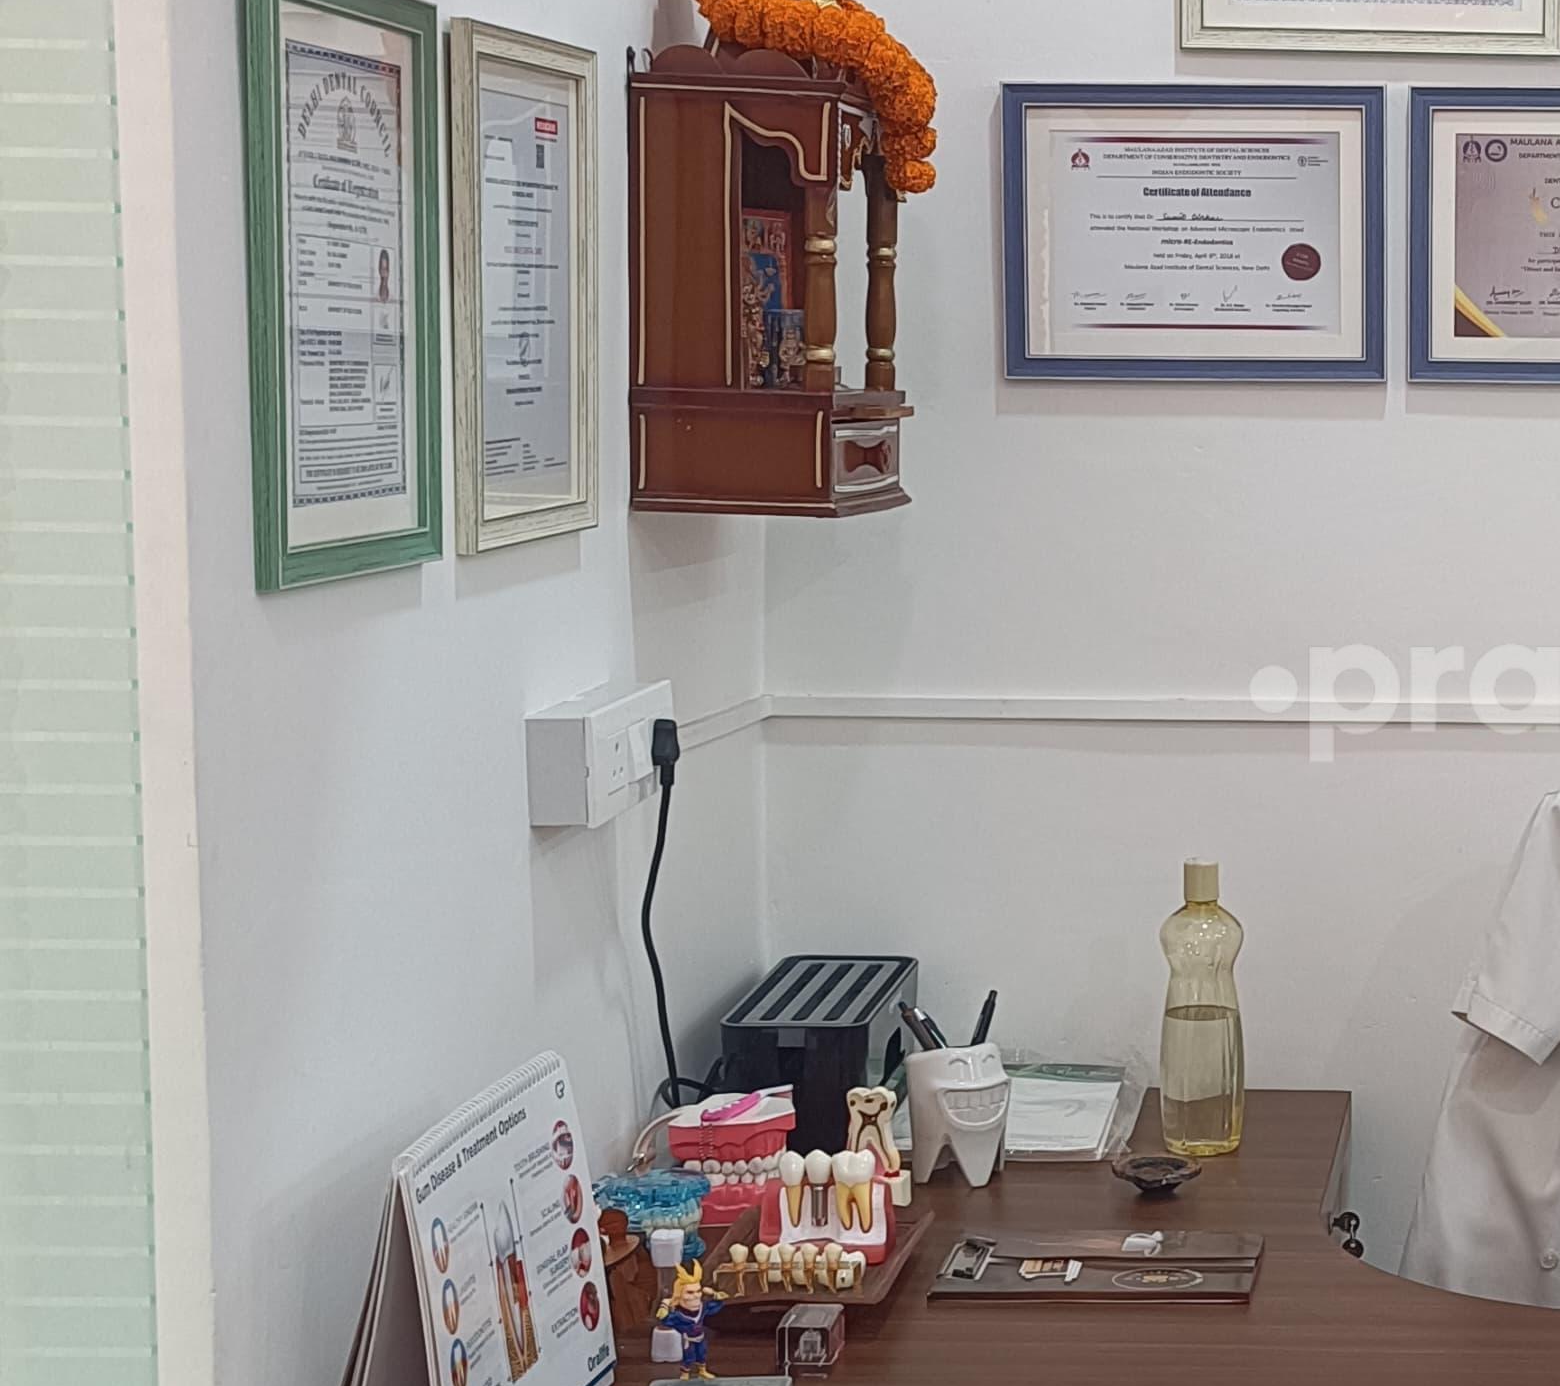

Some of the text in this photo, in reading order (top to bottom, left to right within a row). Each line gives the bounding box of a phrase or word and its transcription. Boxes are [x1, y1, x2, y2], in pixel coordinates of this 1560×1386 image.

[298, 71, 391, 157] DELHI DENTAL COUNCIL
[1510, 138, 1554, 147] MAULANA
[1143, 187, 1252, 198] Certificate of Attendance
[416, 1183, 432, 1204] Gum
[430, 1161, 456, 1191] Disease
[462, 1126, 498, 1163] Treatment
[499, 1108, 527, 1135] Options
